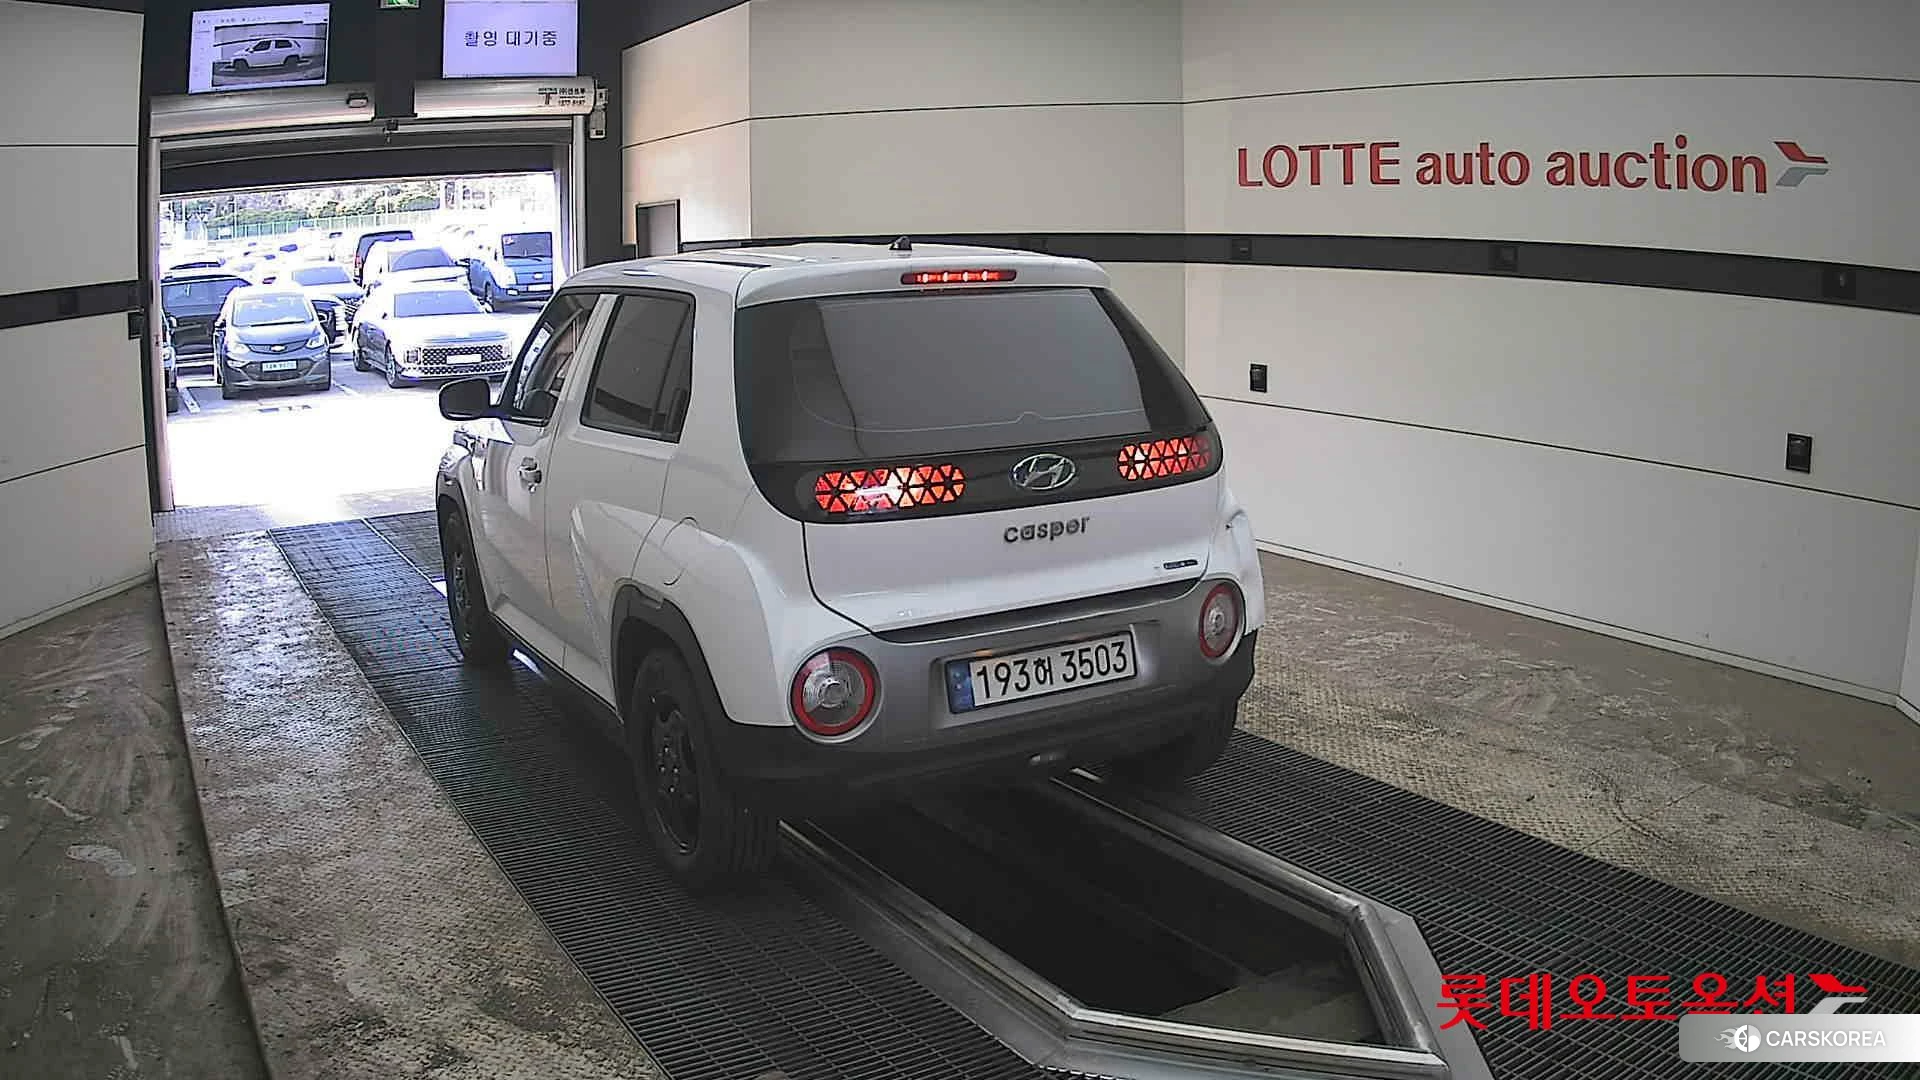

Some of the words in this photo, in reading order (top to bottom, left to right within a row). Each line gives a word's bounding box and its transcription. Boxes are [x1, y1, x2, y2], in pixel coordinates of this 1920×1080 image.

[464, 30, 497, 47] 촬영
[506, 30, 557, 47] 대기중
[1237, 142, 1400, 188] LOTTE
[1416, 142, 1530, 185] auto
[1545, 134, 1768, 193] auction
[1003, 517, 1089, 543] casper
[976, 656, 1053, 699] 193허
[1060, 641, 1127, 683] 3503
